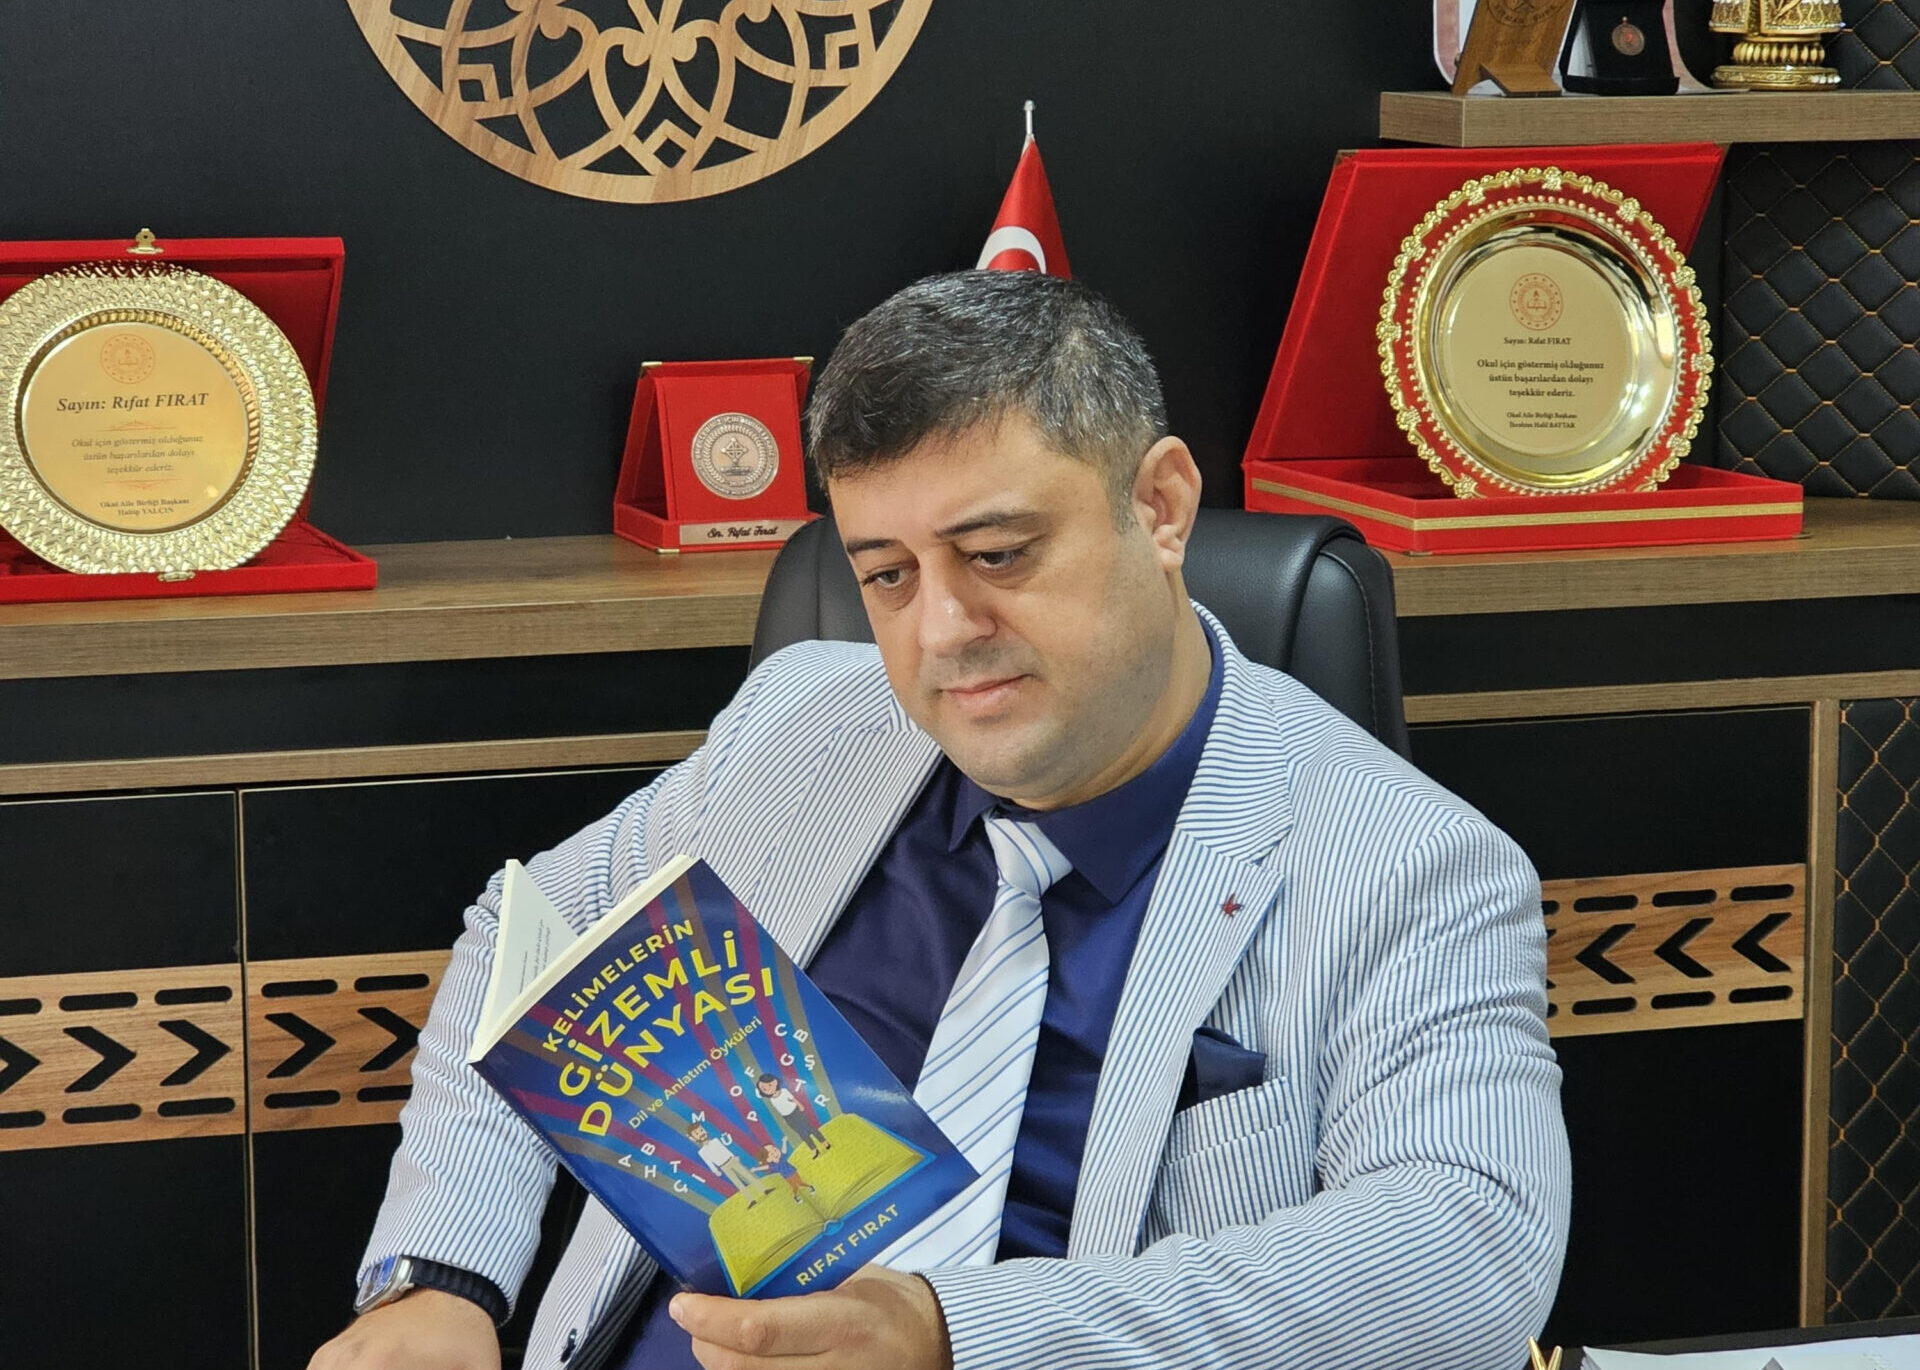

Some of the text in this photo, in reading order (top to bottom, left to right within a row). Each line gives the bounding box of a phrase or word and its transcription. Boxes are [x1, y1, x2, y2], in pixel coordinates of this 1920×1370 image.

[1547, 337, 1571, 345] FIRAT
[1477, 359, 1604, 372] Okul için göstermiş olduğunuz
[1489, 374, 1594, 385] üstün başarılardan dolayı
[1509, 388, 1576, 398] teşekkür ederiz.
[56, 392, 209, 414] Sayın: Rıfat FIRAT
[71, 438, 93, 448] Okul
[542, 919, 694, 1053] KELİMELERİN
[559, 930, 738, 1096] GİZEMLİ
[793, 1028, 809, 1043] B
[578, 967, 774, 1137] DÜNYASI
[628, 1016, 762, 1129] Dil ve Anlatım Öyküleri
[794, 1078, 807, 1092] T
[814, 1093, 831, 1107] R
[640, 1142, 656, 1157] B
[618, 1154, 632, 1168] A
[670, 1160, 681, 1173] T
[644, 1165, 657, 1178] H
[796, 1204, 898, 1286] RIFAT FIRAT
